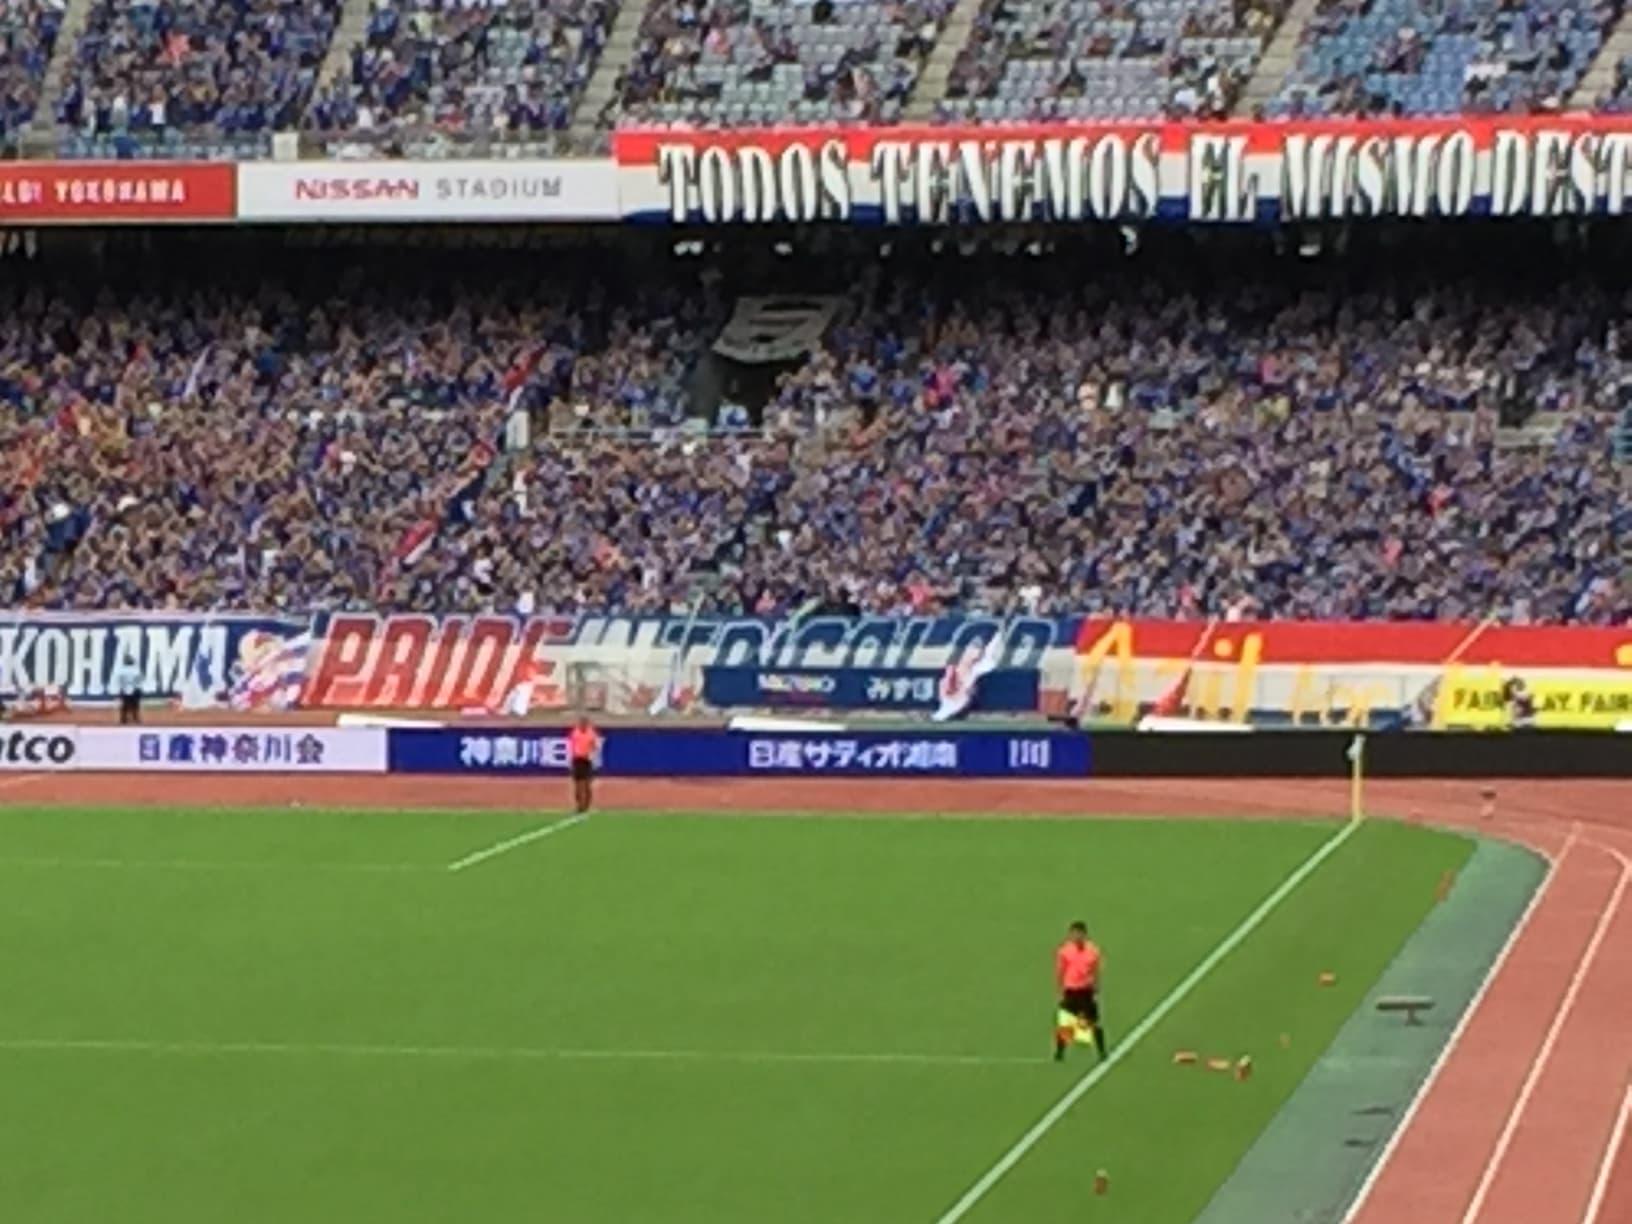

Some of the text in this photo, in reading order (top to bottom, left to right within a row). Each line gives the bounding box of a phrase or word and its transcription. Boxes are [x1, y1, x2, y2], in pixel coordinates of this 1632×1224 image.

[294, 178, 562, 200] NISSAN STADIUM
[657, 139, 850, 222] TODOS
[870, 133, 1158, 223] TENEMOS
[1189, 132, 1259, 222] EL
[1280, 130, 1474, 222] MISMO
[54, 180, 186, 204] YOKOHAMA
[300, 612, 573, 706] PRIDE
[139, 734, 324, 764] 日産神奈川会
